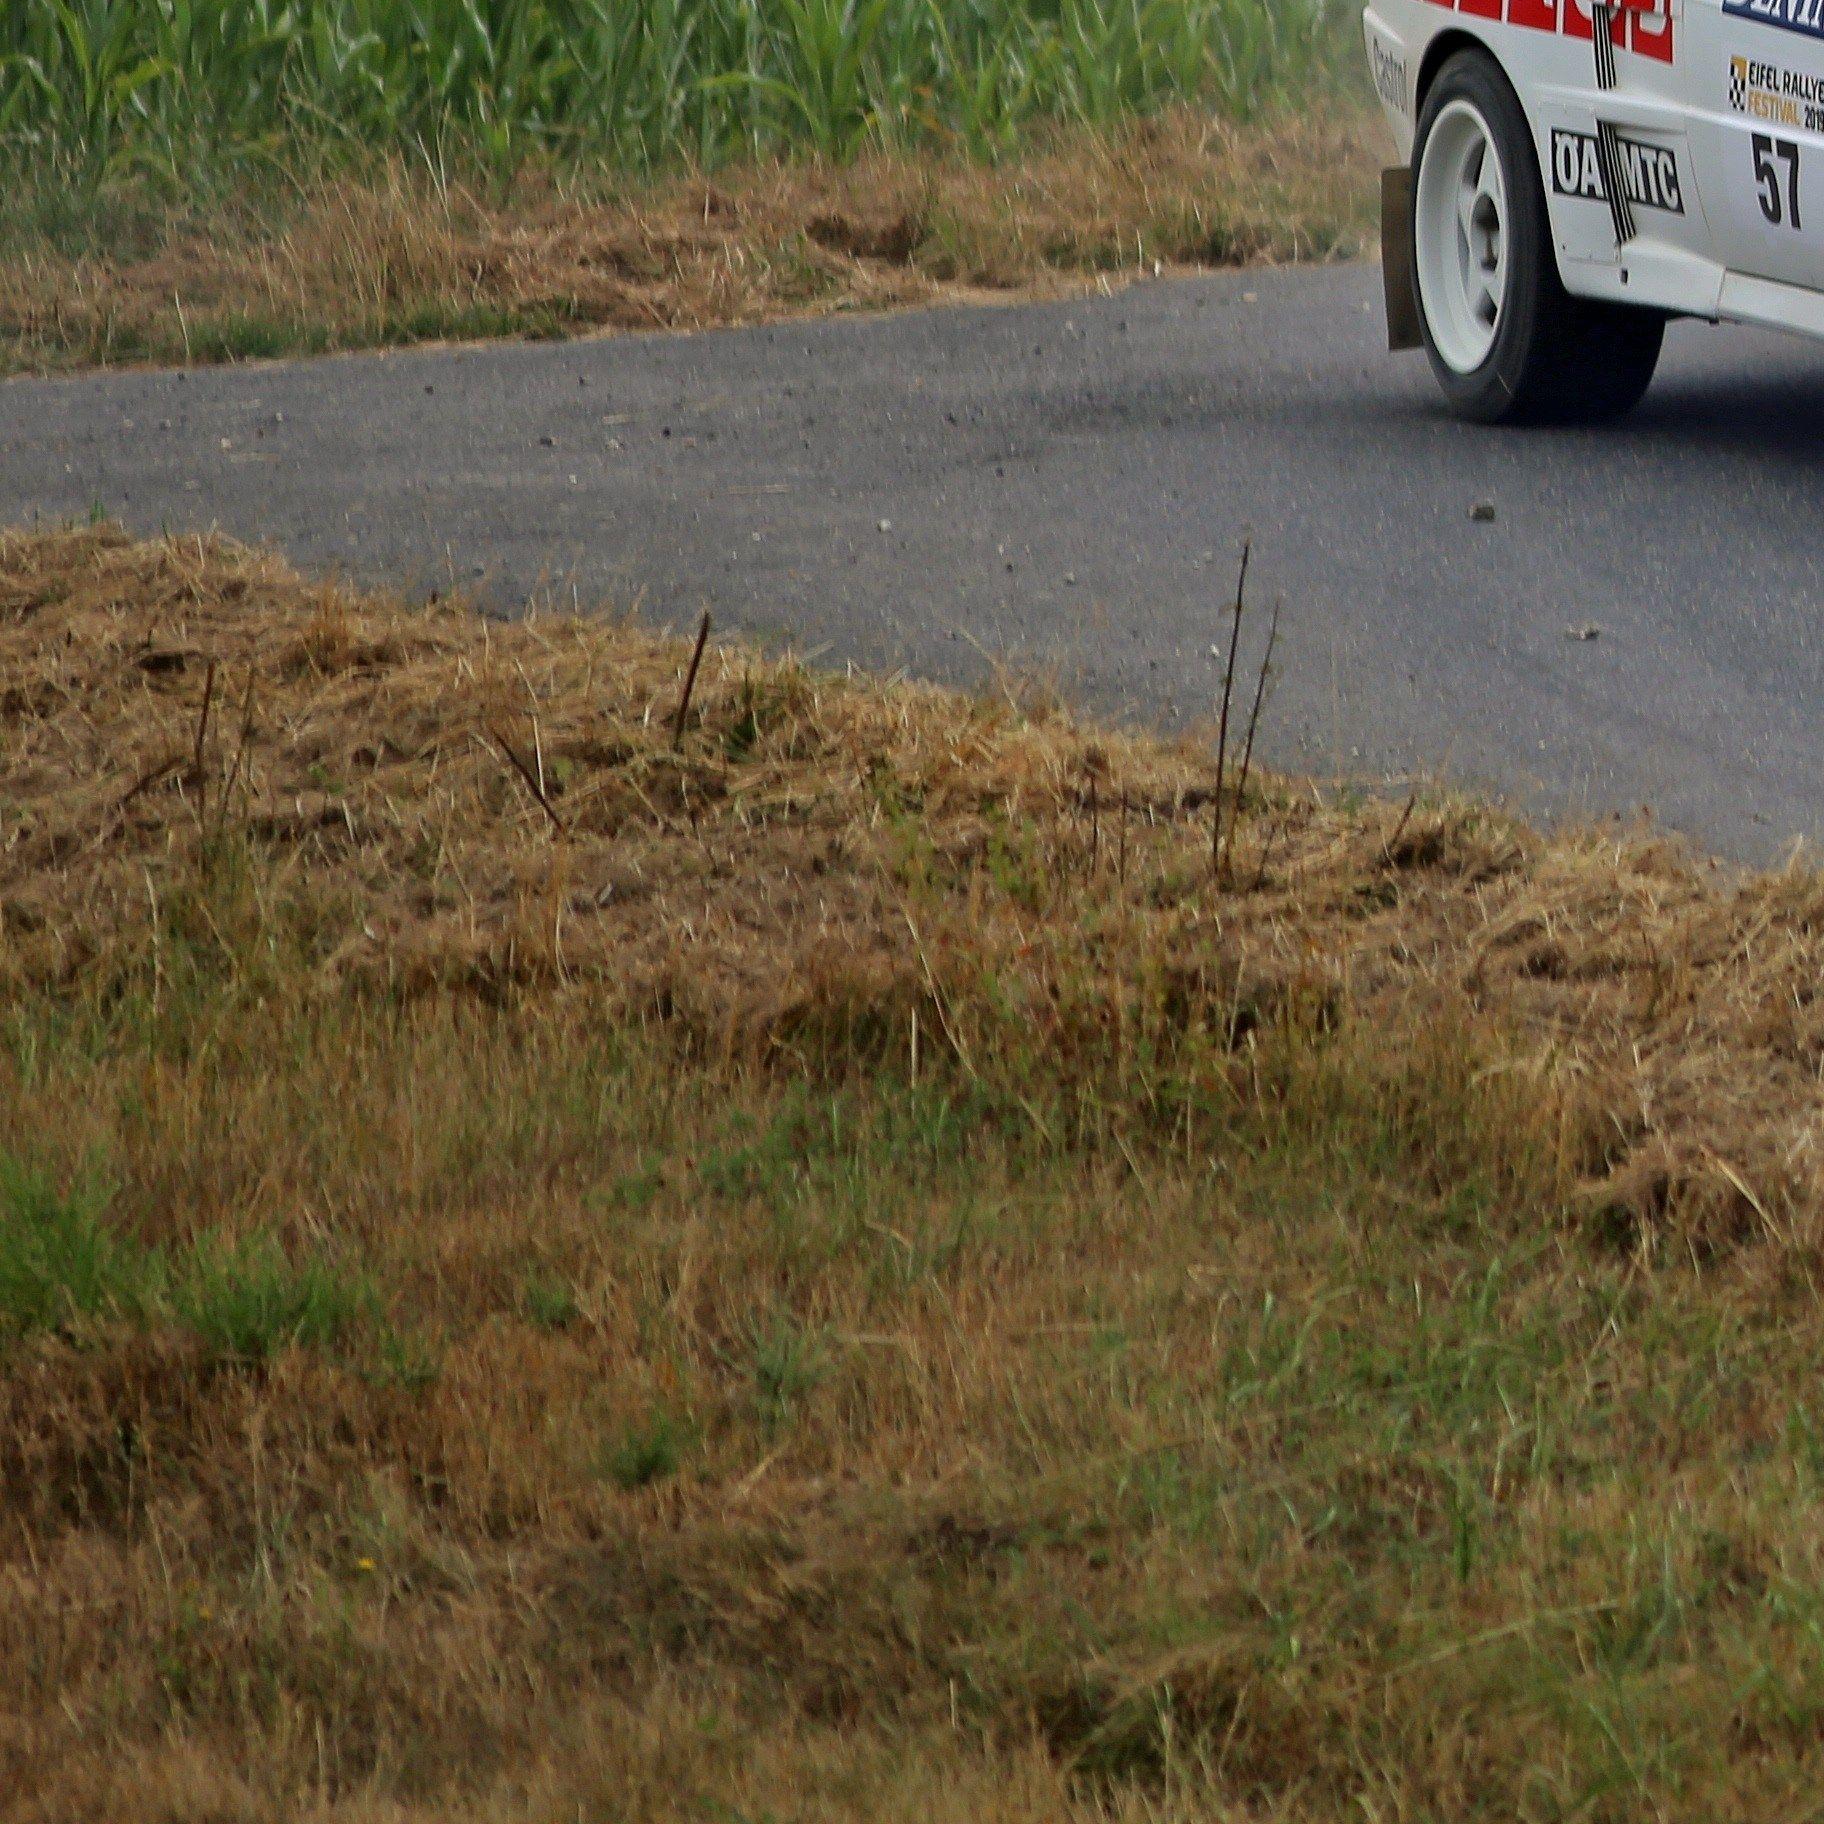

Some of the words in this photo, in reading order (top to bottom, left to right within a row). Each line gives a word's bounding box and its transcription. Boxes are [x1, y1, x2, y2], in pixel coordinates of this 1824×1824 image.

[1749, 61, 1780, 92] EIFEL
[1749, 88, 1800, 126] FESTIVAL
[1751, 132, 1801, 230] 57
